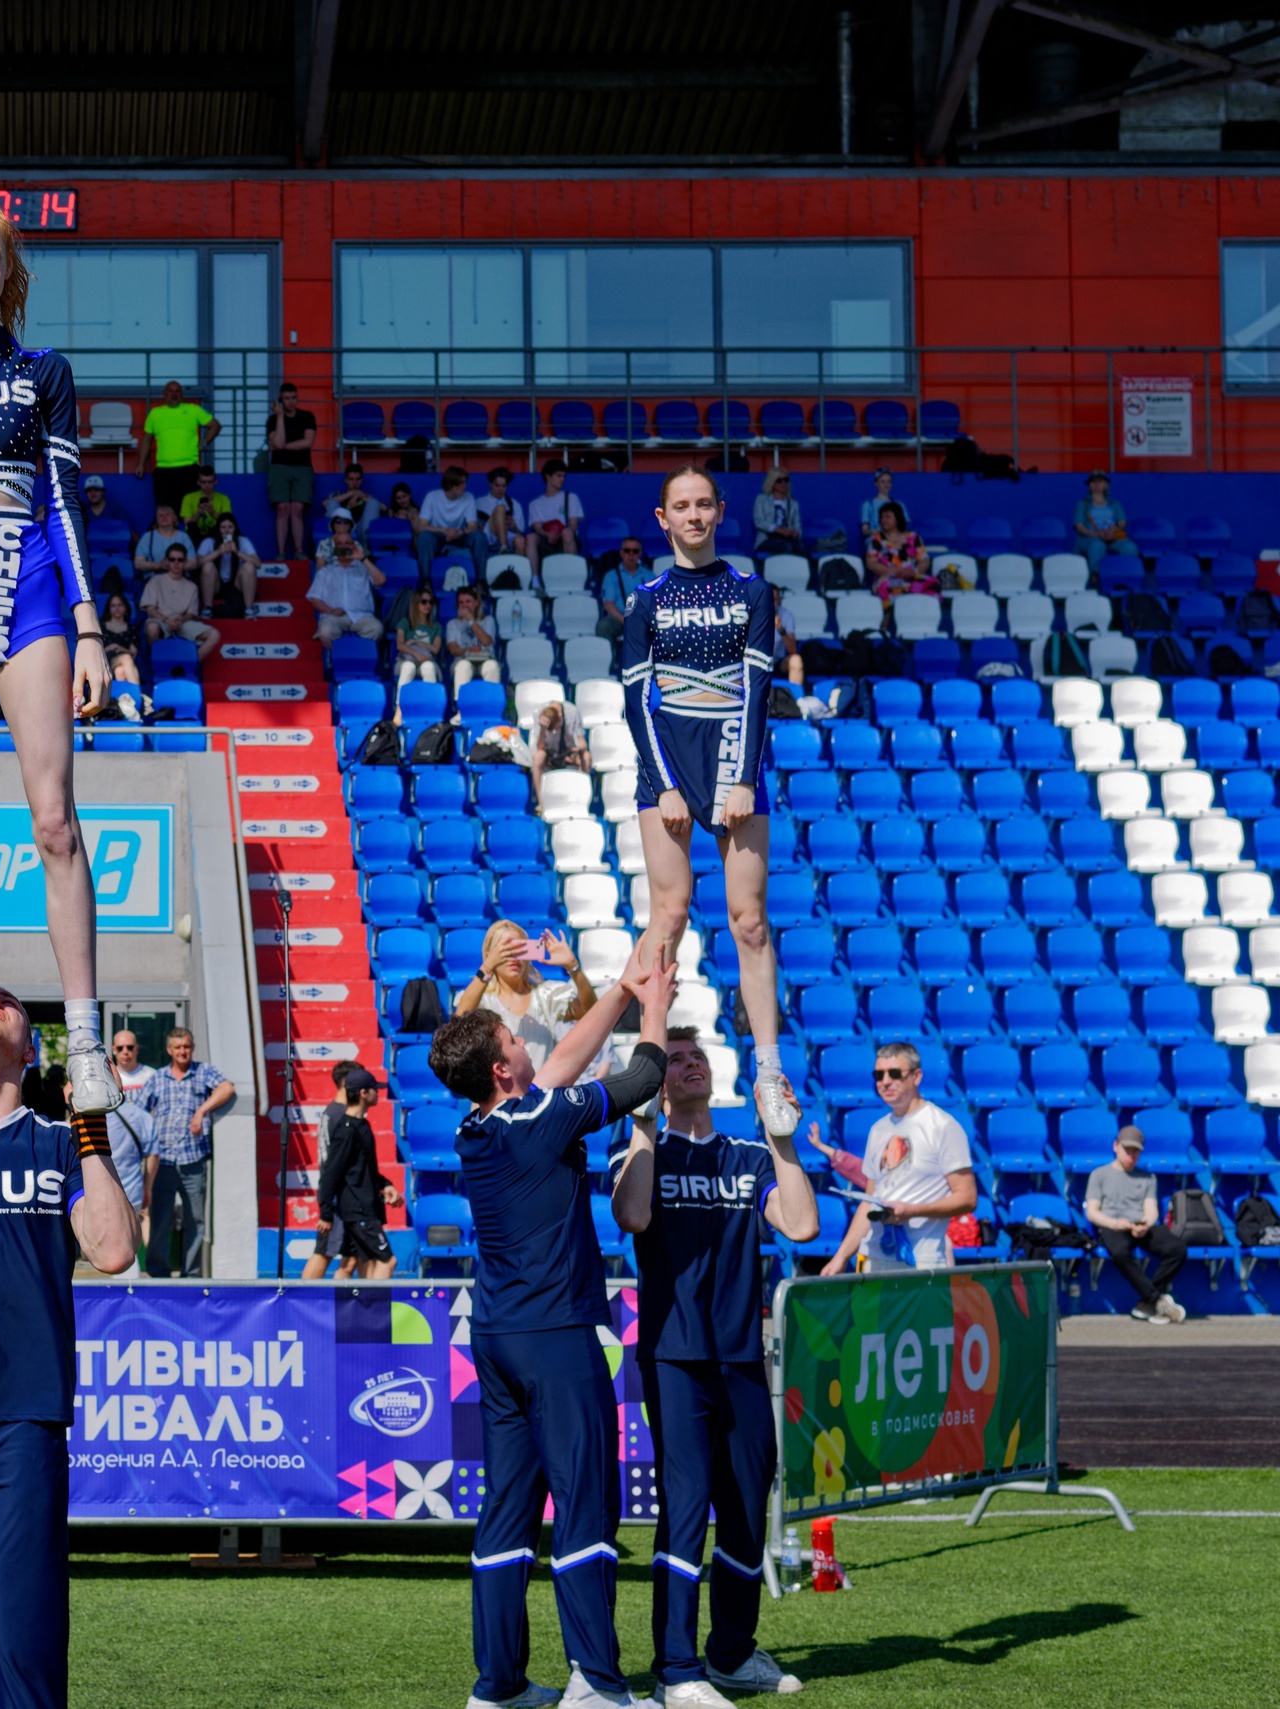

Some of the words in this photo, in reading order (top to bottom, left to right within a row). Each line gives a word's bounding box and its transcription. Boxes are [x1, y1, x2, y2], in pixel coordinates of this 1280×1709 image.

[656, 603, 749, 629] SIRIUS
[254, 647, 266, 656] 12
[262, 689, 271, 697] 11
[265, 733, 278, 742] 10
[273, 779, 280, 788] 9
[279, 824, 287, 833] 8
[275, 932, 282, 942] 6
[293, 1109, 301, 1119] 3
[302, 1175, 309, 1186] 2
[660, 1174, 756, 1201] SIRIUS
[365, 1377, 376, 1389] 25
[376, 1371, 394, 1383] ЛЕТ
[160, 1448, 202, 1468] А.А.
[211, 1448, 305, 1469] Леонова
